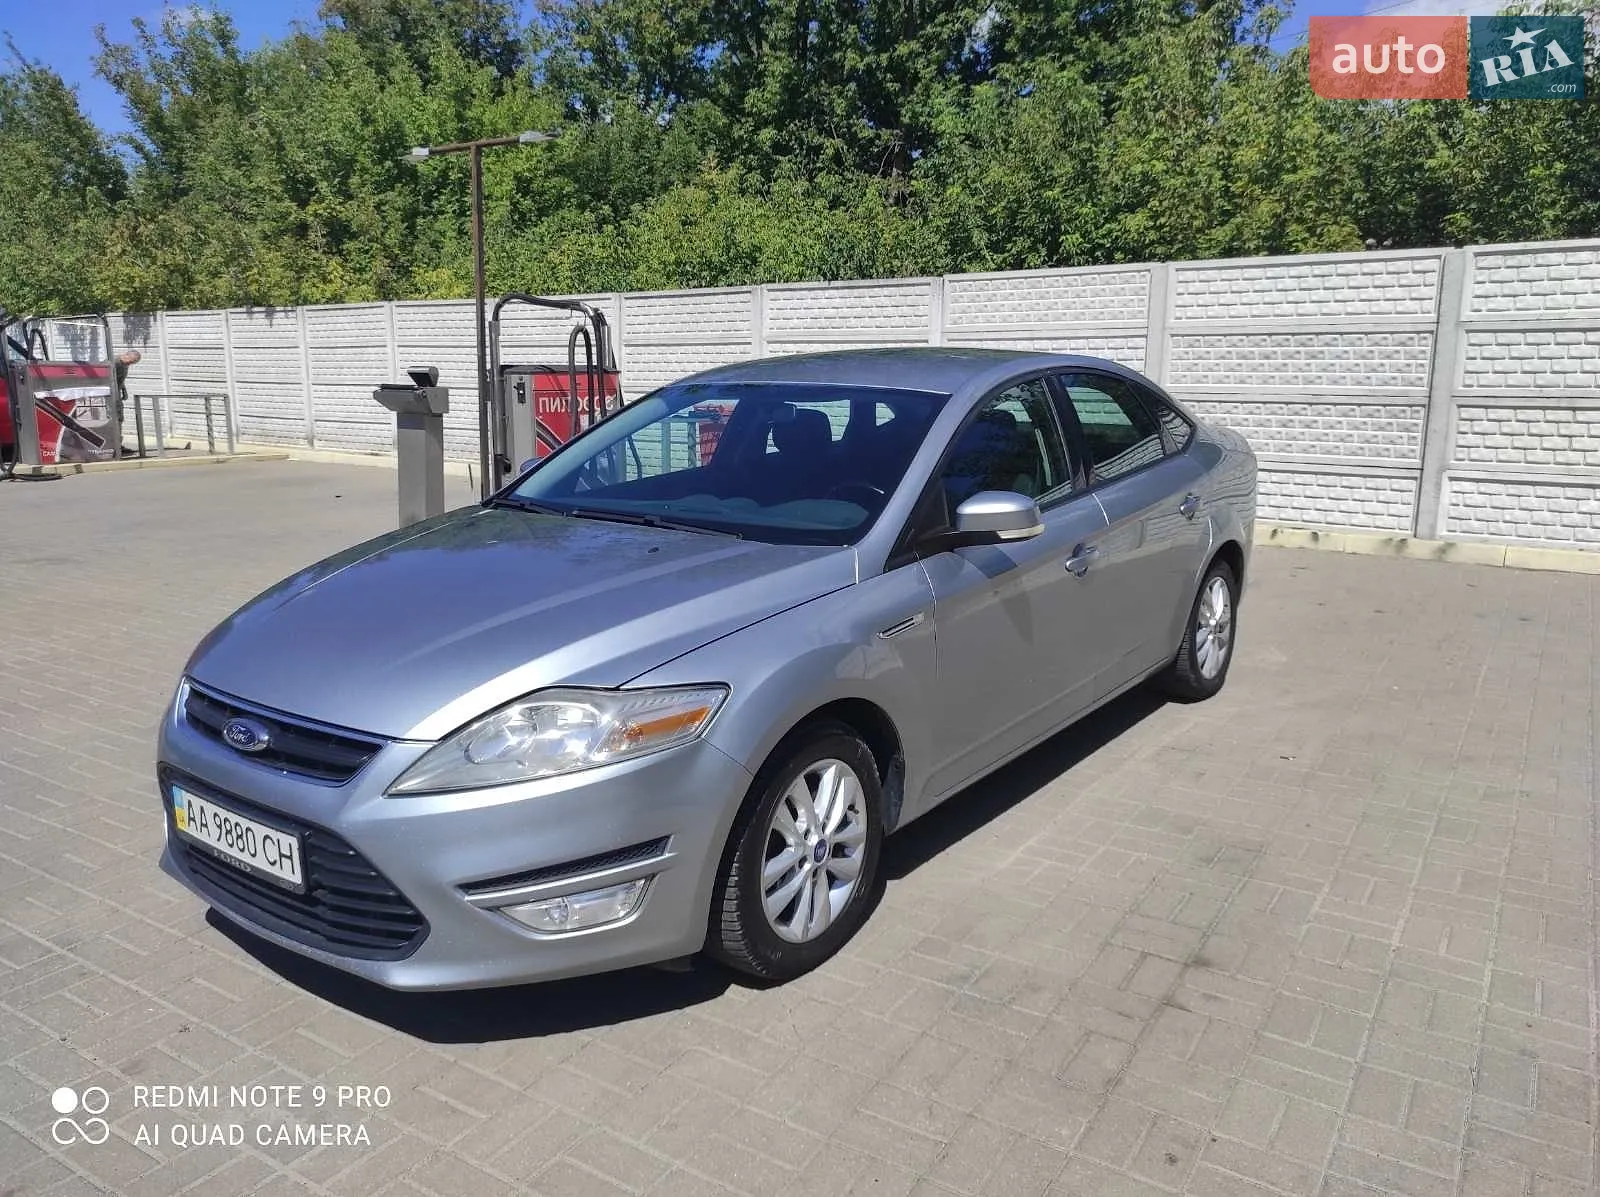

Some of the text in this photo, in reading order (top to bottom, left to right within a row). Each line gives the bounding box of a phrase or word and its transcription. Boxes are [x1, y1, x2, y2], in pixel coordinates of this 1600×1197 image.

[230, 725, 251, 743] Ford
[187, 799, 295, 875] AA 9880 CH
